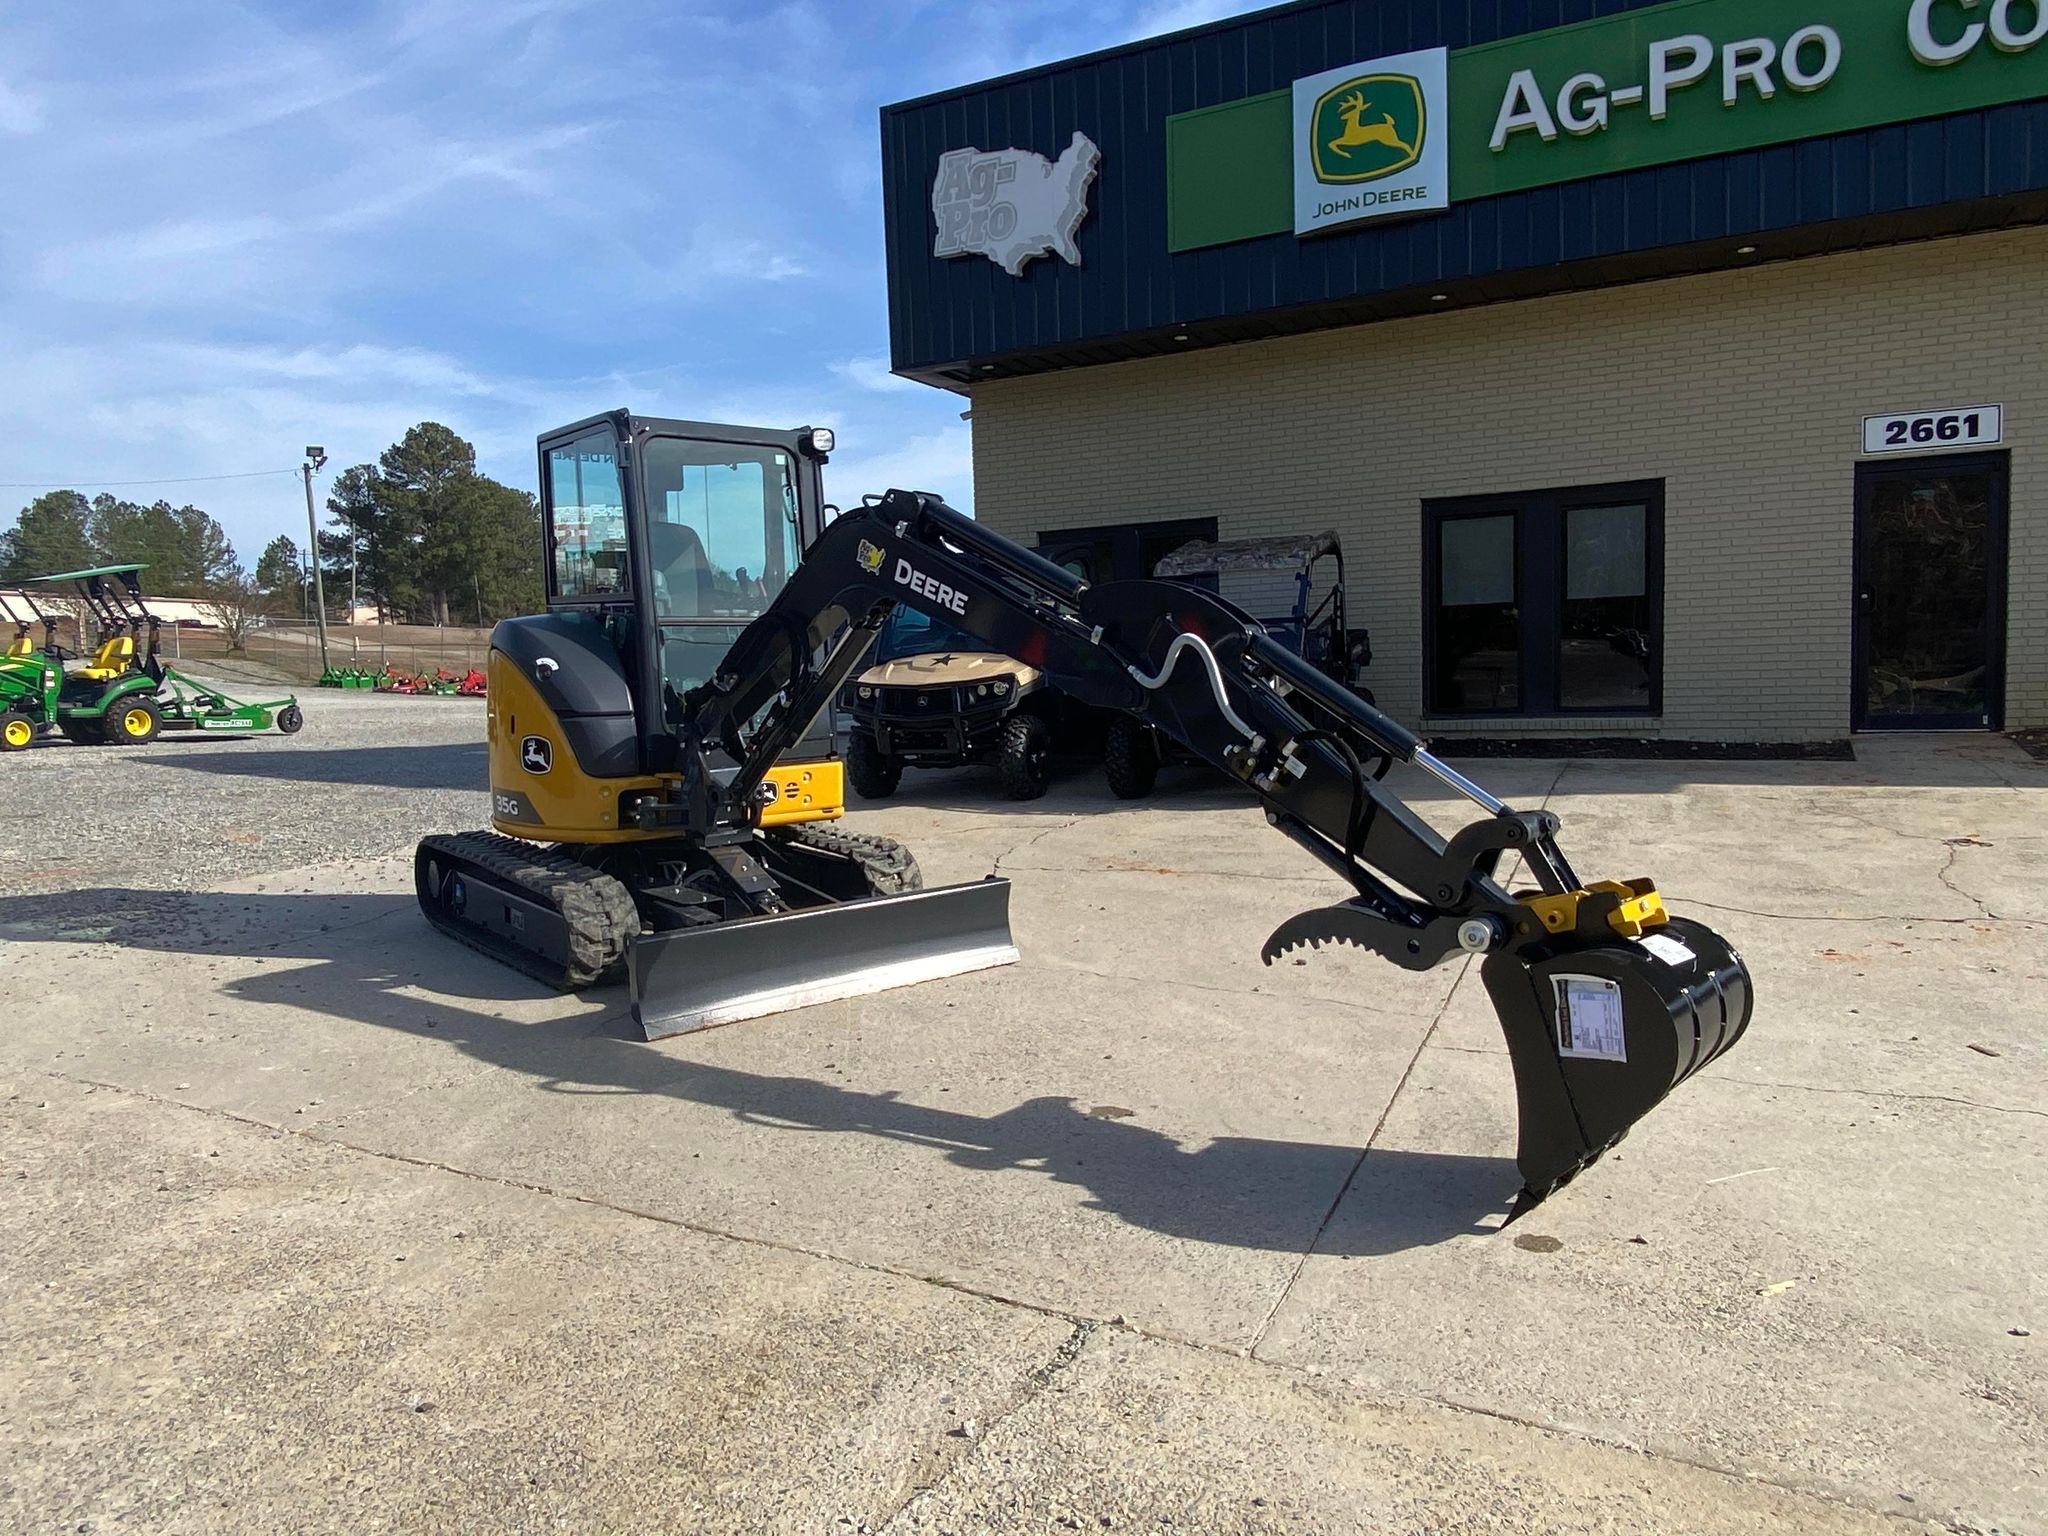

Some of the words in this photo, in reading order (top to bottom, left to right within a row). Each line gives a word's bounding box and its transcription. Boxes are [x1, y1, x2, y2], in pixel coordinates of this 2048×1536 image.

[1312, 197, 1360, 219] JOHN
[1363, 186, 1428, 207] DEERE
[937, 202, 1016, 250] Pro
[1885, 413, 1980, 445] 2661
[894, 558, 969, 616] DEERE
[496, 795, 519, 816] 35G
